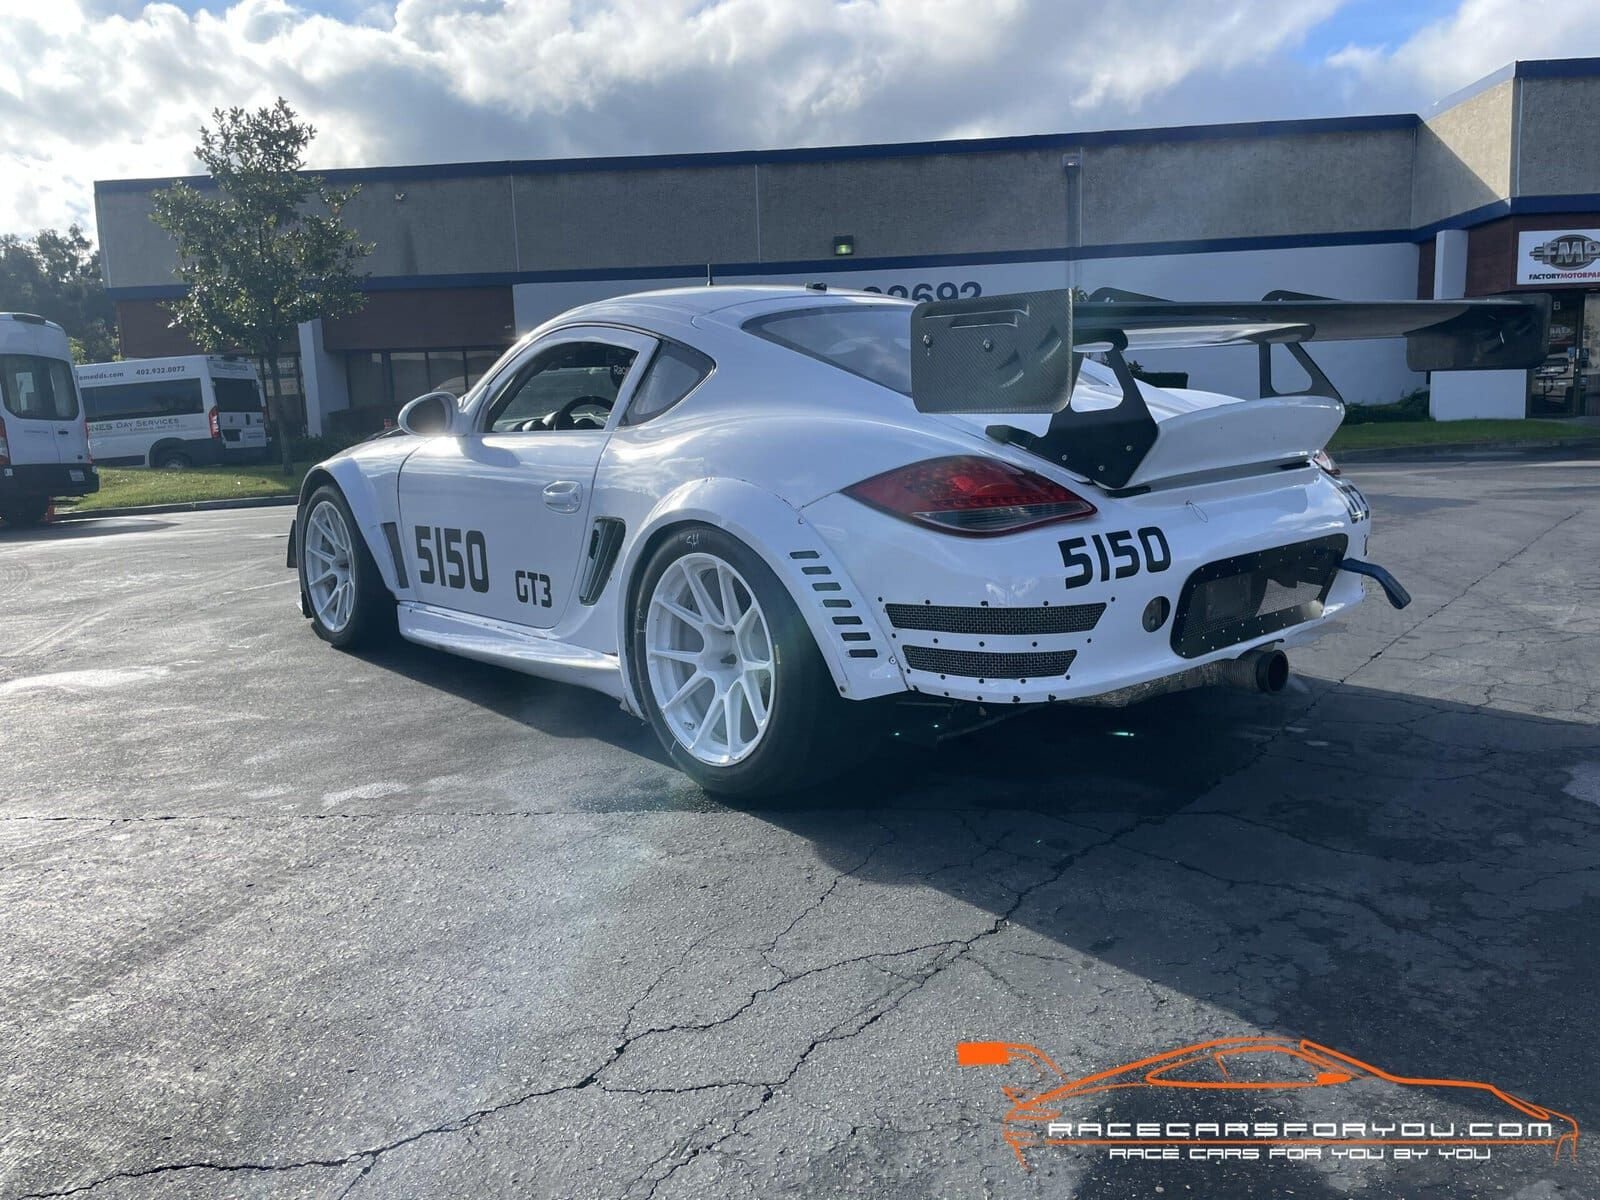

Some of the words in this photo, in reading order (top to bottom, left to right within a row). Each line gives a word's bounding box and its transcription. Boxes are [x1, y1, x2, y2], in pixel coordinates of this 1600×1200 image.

[414, 525, 489, 593] 5150
[515, 570, 552, 608] GT3
[1057, 526, 1171, 590] 5150
